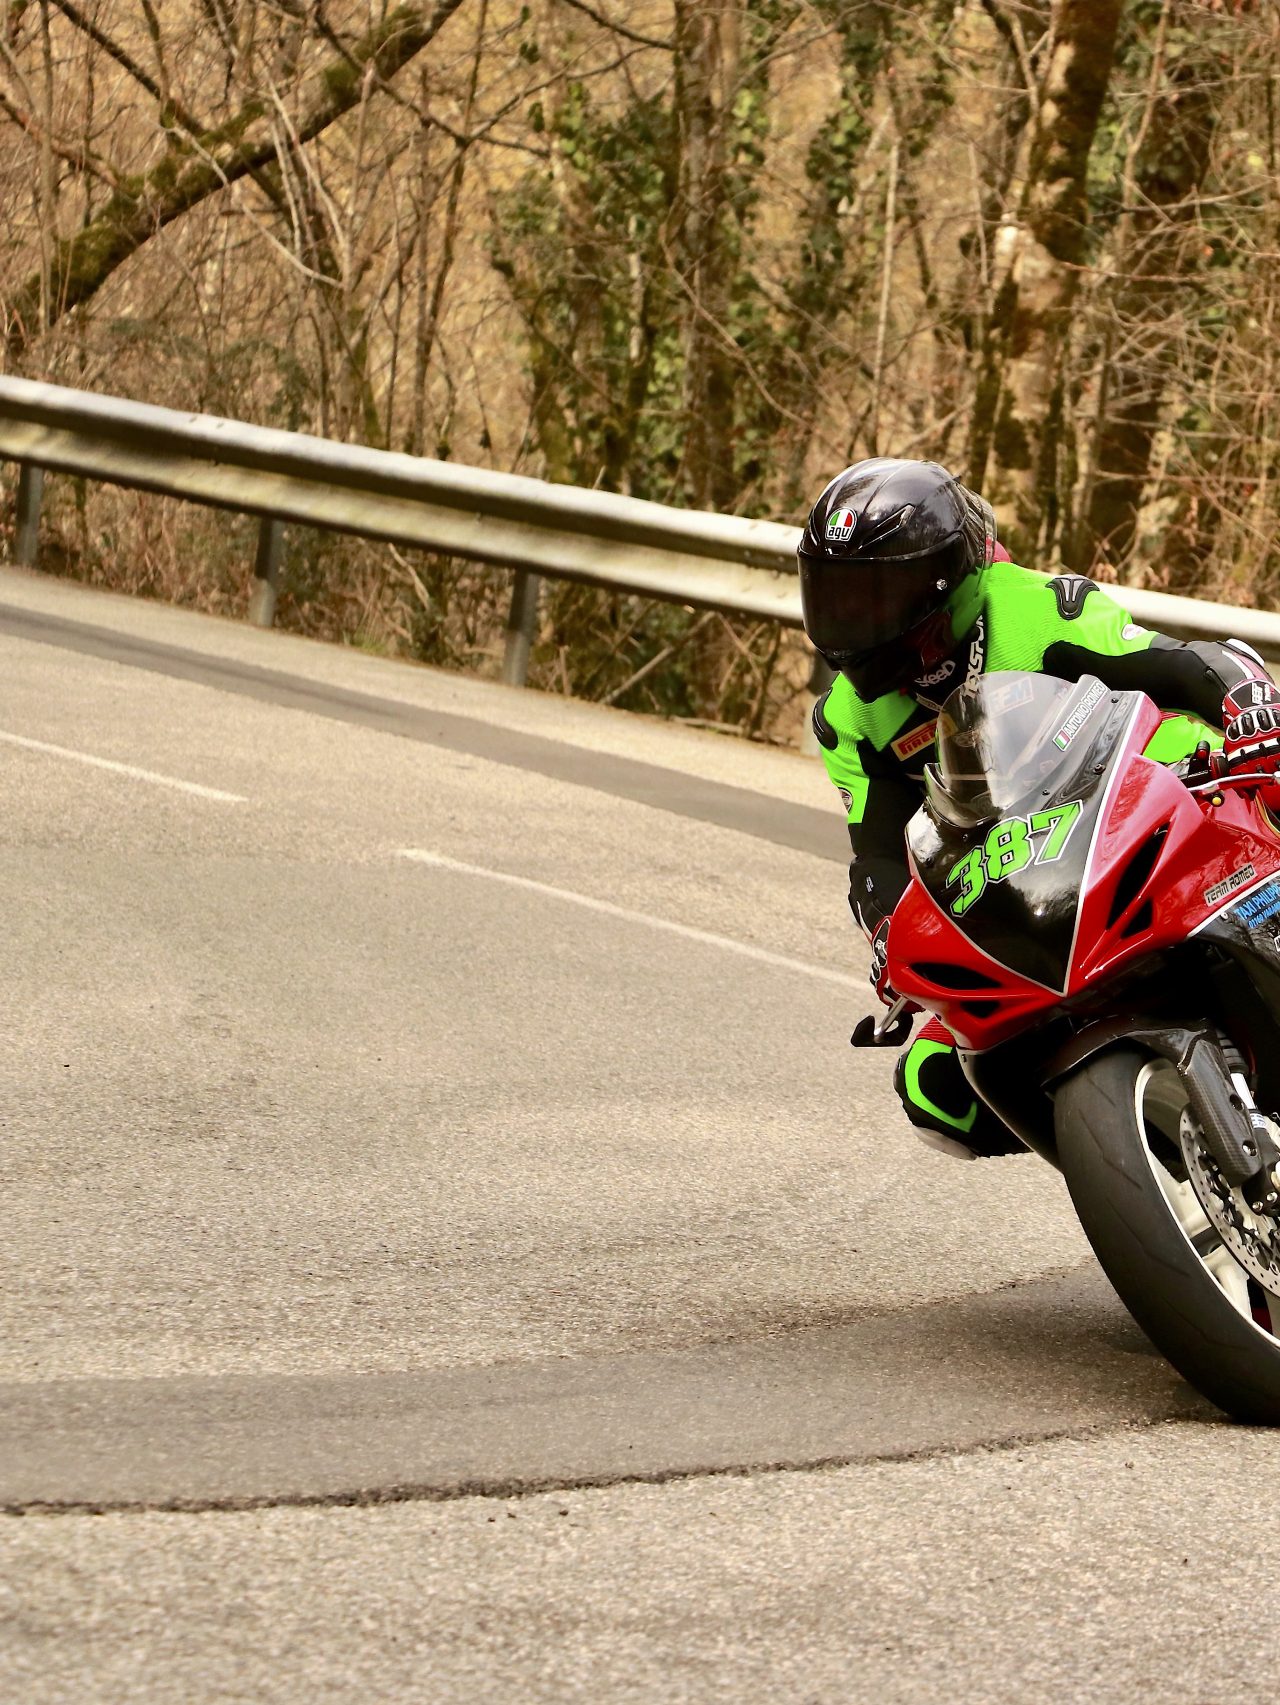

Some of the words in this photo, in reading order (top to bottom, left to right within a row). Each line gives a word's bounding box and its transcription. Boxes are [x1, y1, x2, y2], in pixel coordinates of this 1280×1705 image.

[828, 525, 850, 539] agv
[1063, 704, 1089, 737] ANTONIO
[1088, 681, 1107, 710] ROMEO
[946, 800, 1083, 917] 387
[1206, 880, 1229, 903] TEAM
[1230, 864, 1255, 890] ROMEO
[1233, 895, 1257, 920] TAXI
